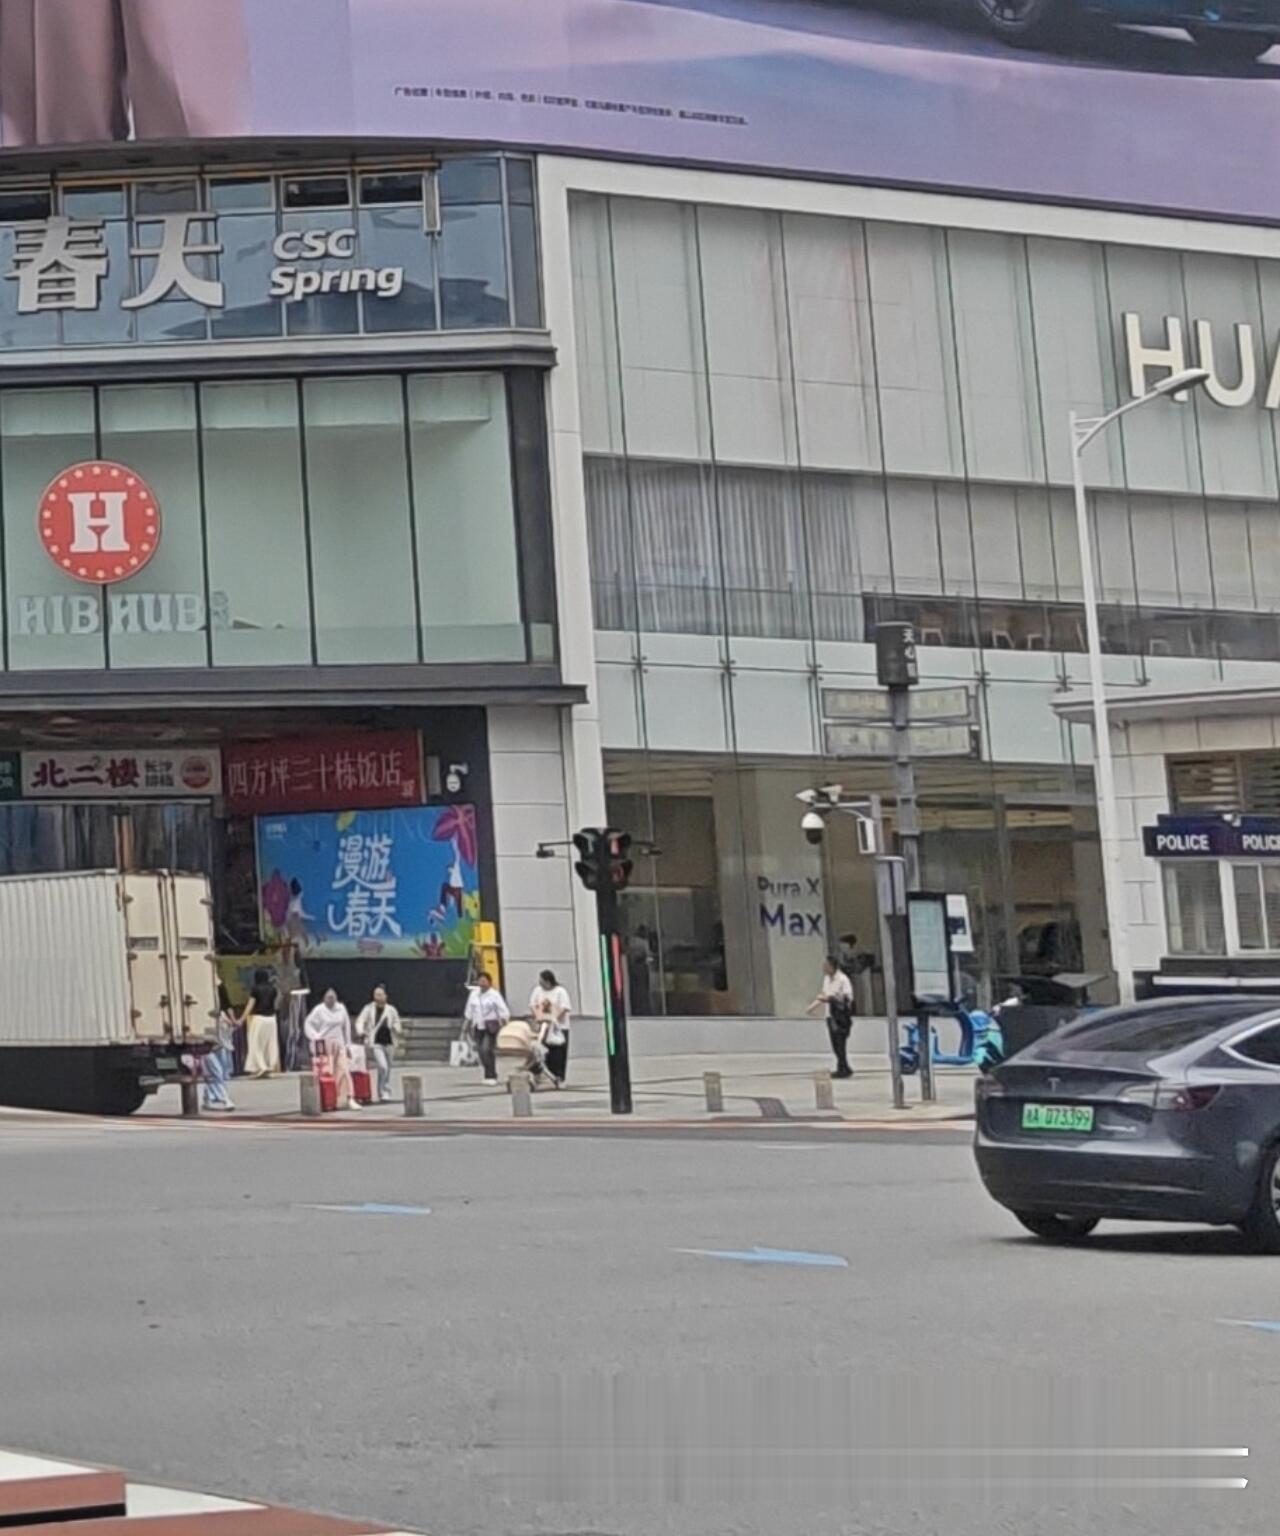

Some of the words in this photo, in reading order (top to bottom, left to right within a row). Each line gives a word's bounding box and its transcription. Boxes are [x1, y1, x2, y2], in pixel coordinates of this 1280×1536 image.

[272, 227, 358, 260] CSC
[268, 266, 404, 301] Spring
[1122, 311, 1280, 410] HU
[227, 750, 403, 797] 四方坪三十栋饭店
[1156, 834, 1210, 851] POLICE
[331, 833, 397, 890] 漫游
[757, 875, 803, 898] Pura
[804, 876, 821, 897] X
[327, 884, 402, 937] 春天
[758, 903, 823, 938] Max
